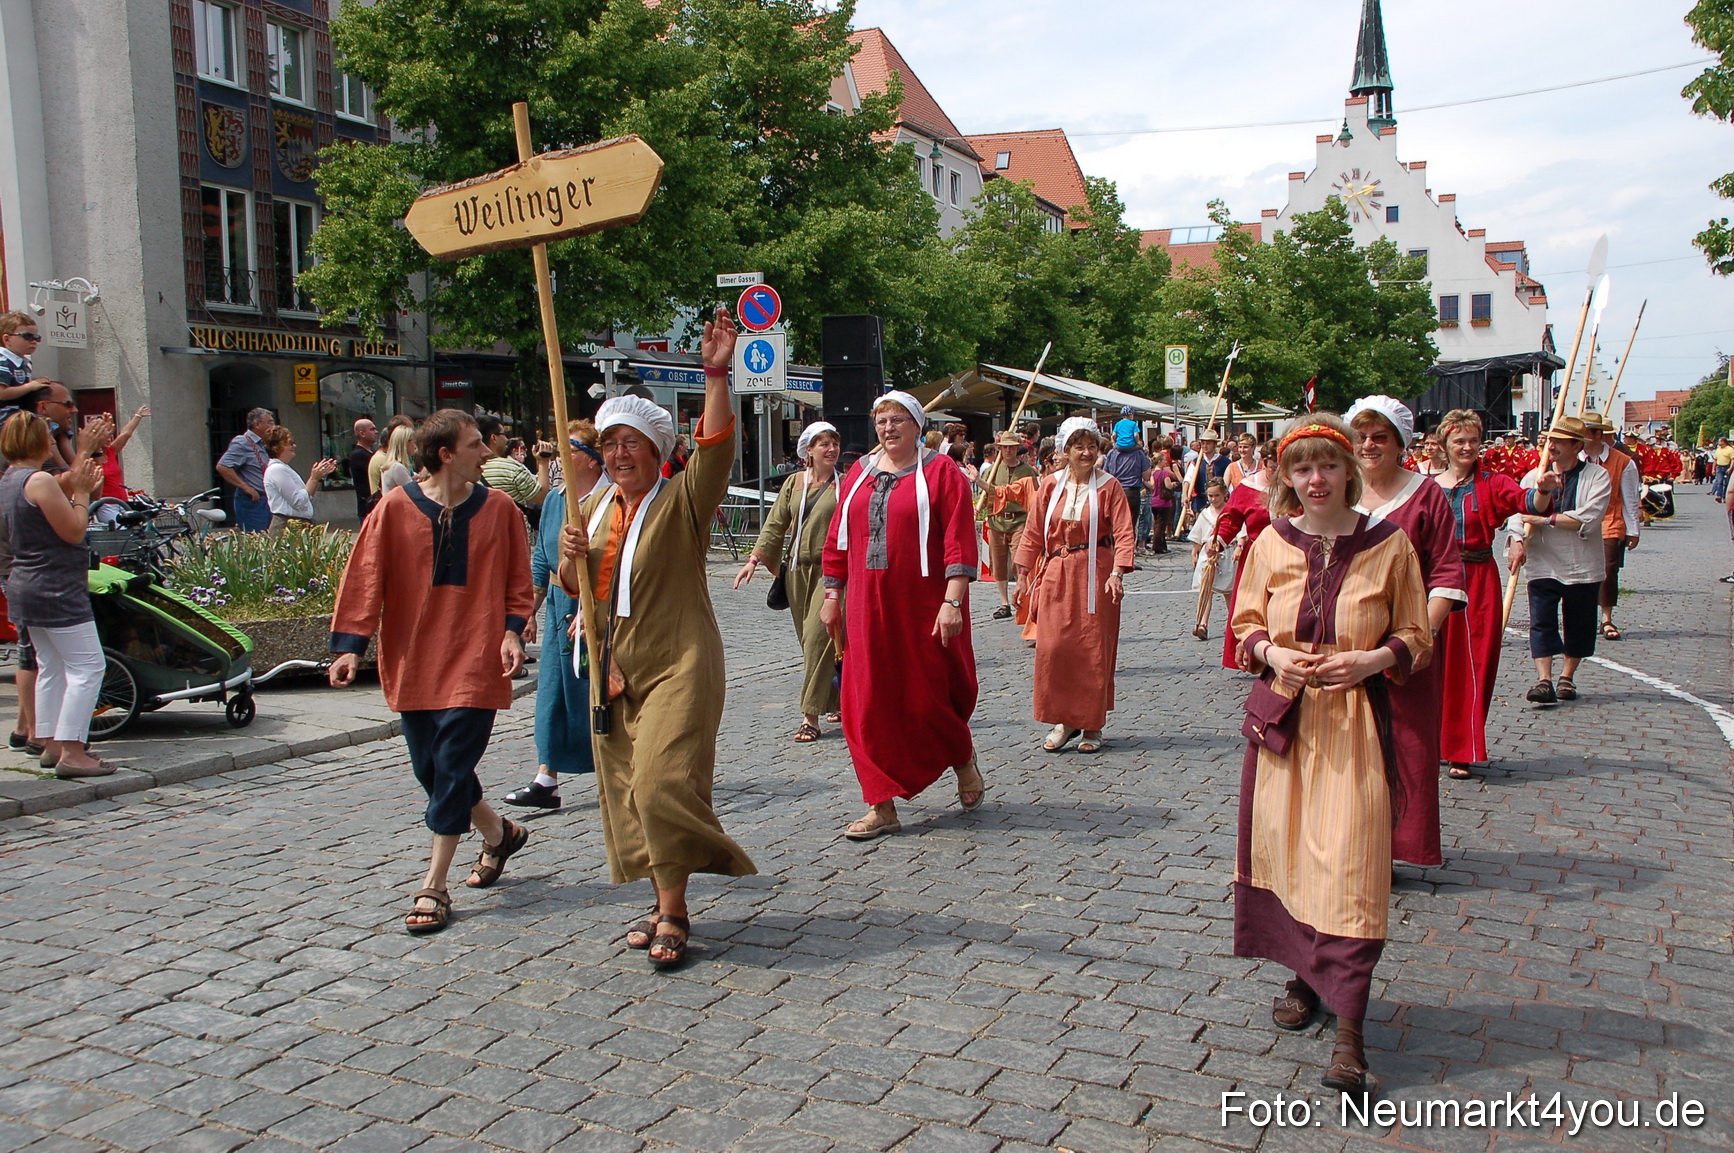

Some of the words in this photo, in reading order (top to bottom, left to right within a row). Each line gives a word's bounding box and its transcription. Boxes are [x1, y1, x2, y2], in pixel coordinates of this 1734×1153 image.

[720, 276, 737, 284] Ulmer
[738, 275, 756, 283] Gasse
[194, 326, 342, 357] BUCHHANDLUNG
[1173, 353, 1180, 361] H
[668, 371, 688, 381] OBST
